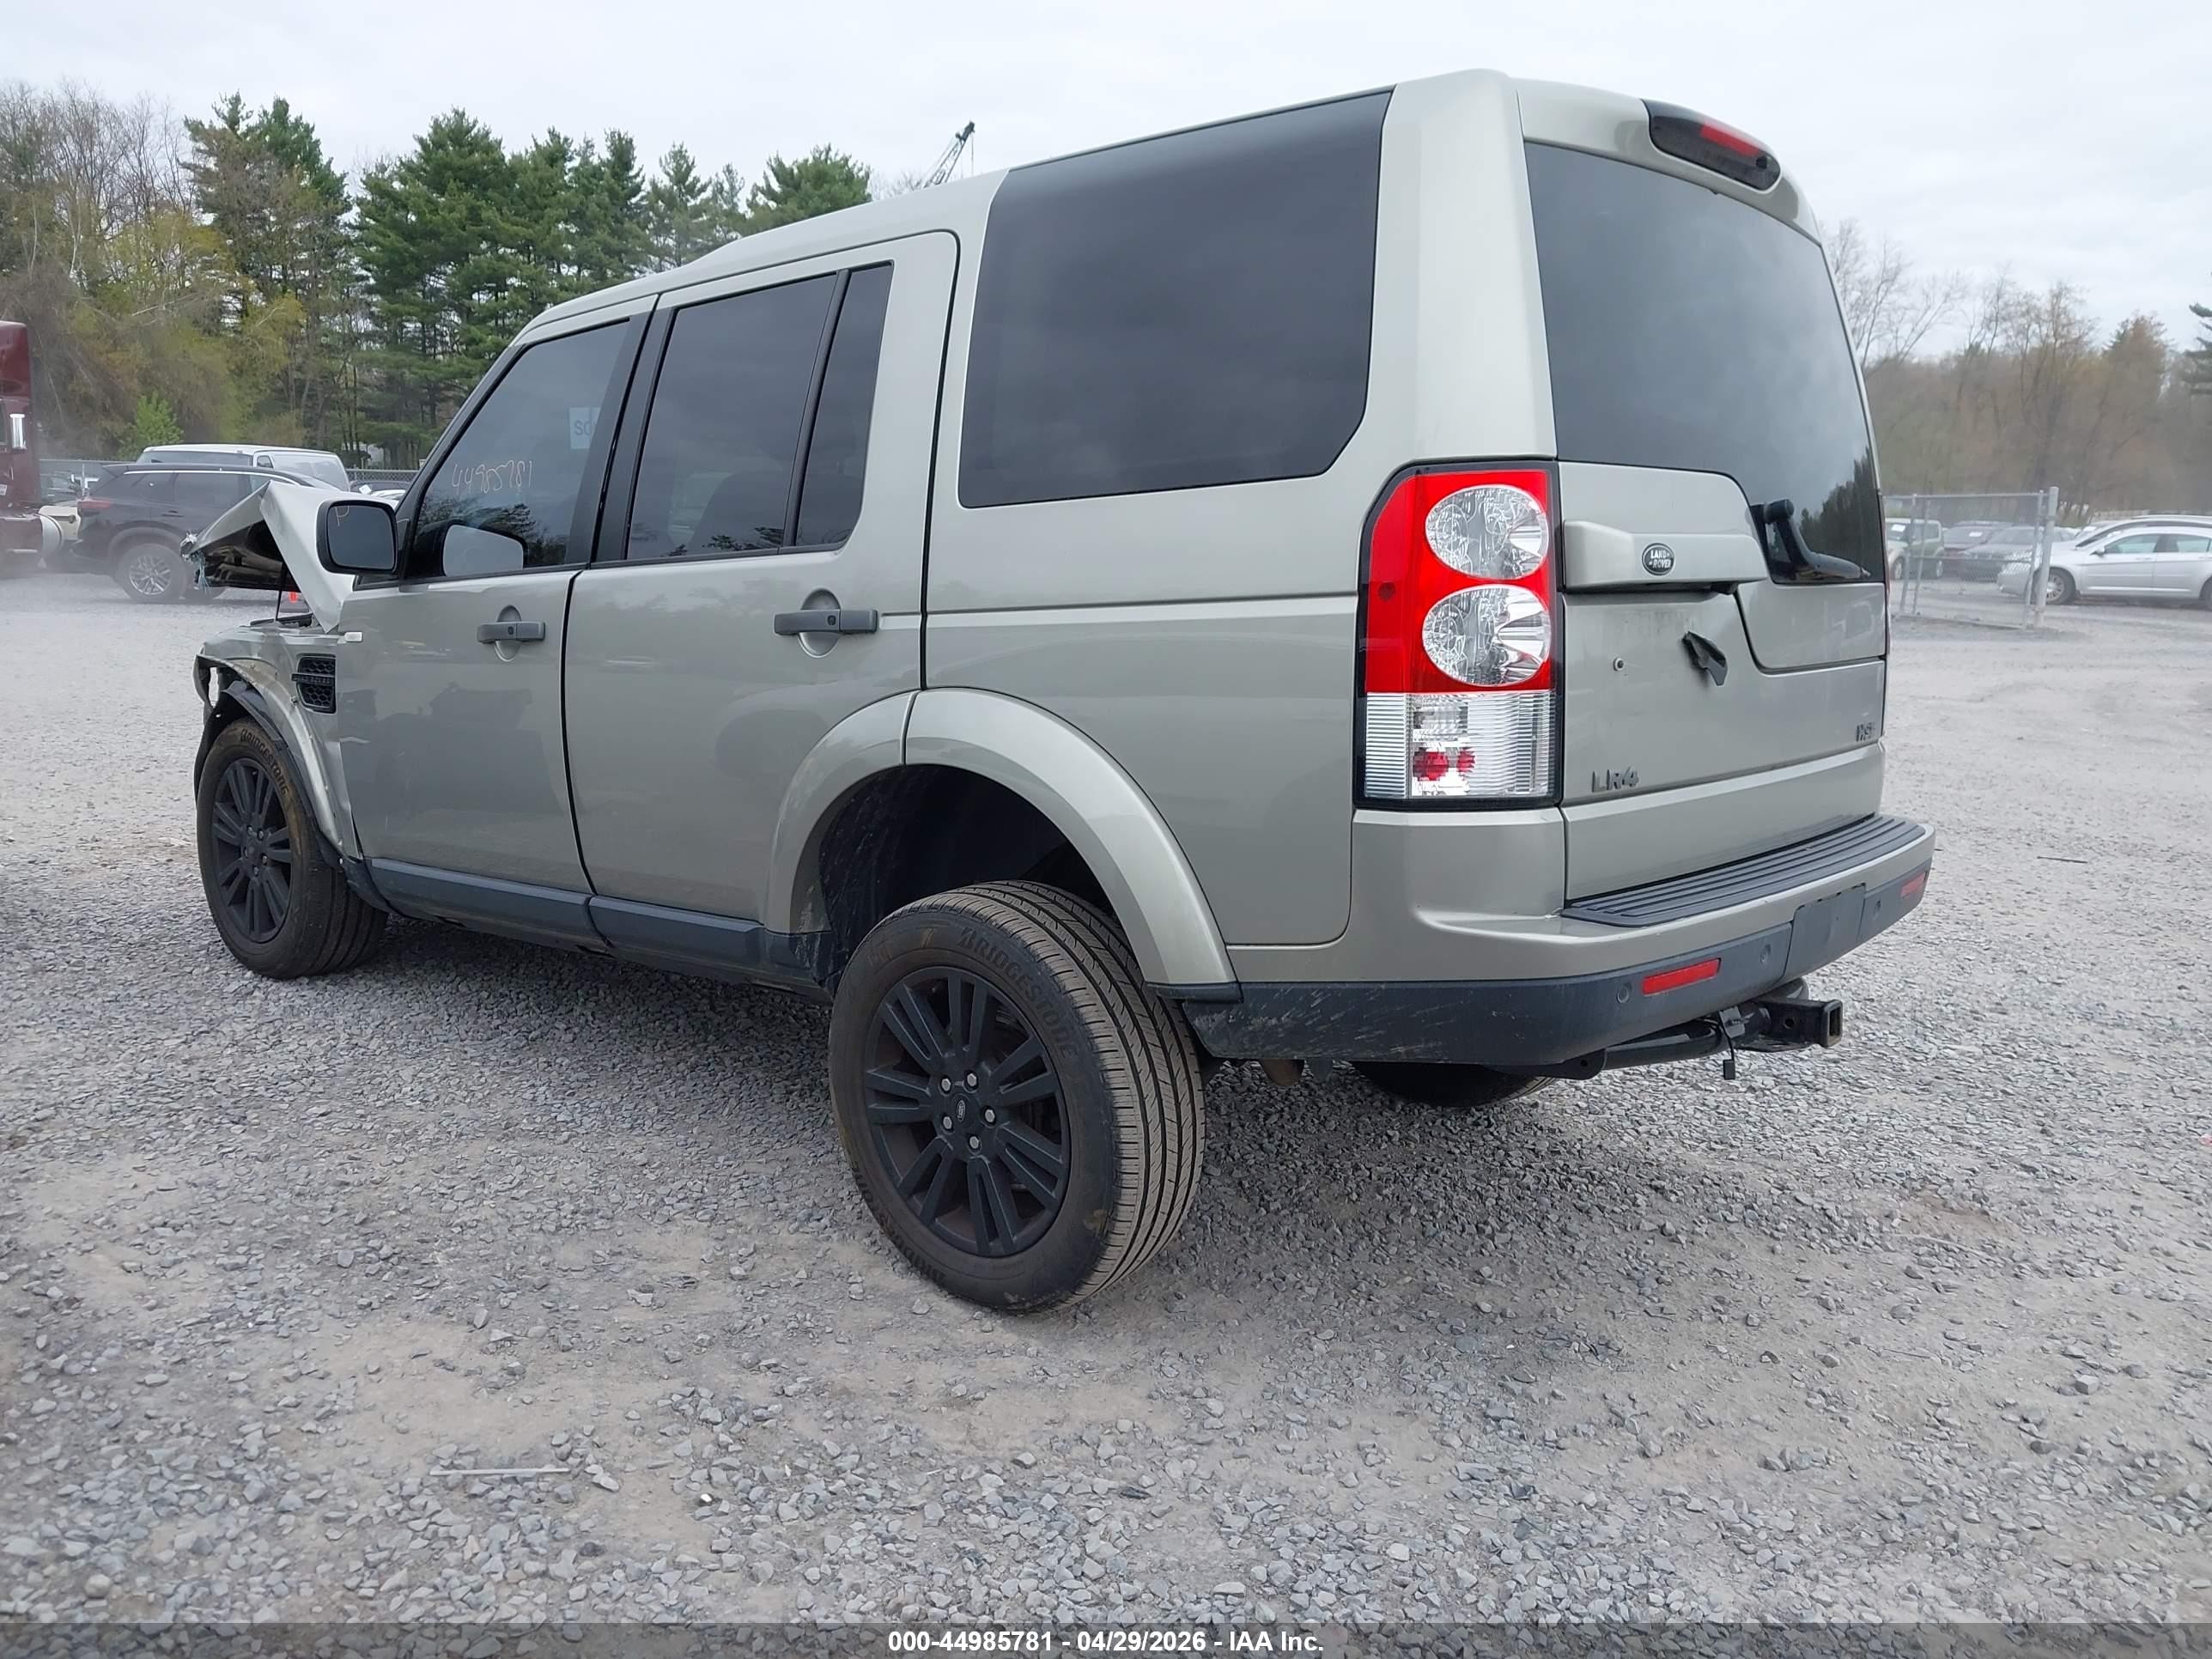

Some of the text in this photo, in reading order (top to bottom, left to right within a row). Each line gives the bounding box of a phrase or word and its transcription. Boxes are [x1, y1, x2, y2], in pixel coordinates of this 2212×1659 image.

[1650, 549, 1667, 559] LAND
[1652, 558, 1672, 568] ROVER
[240, 728, 289, 795] BRIDGESTONE
[1591, 766, 1639, 793] LR4
[957, 927, 1078, 1059] BRIDGESTONE
